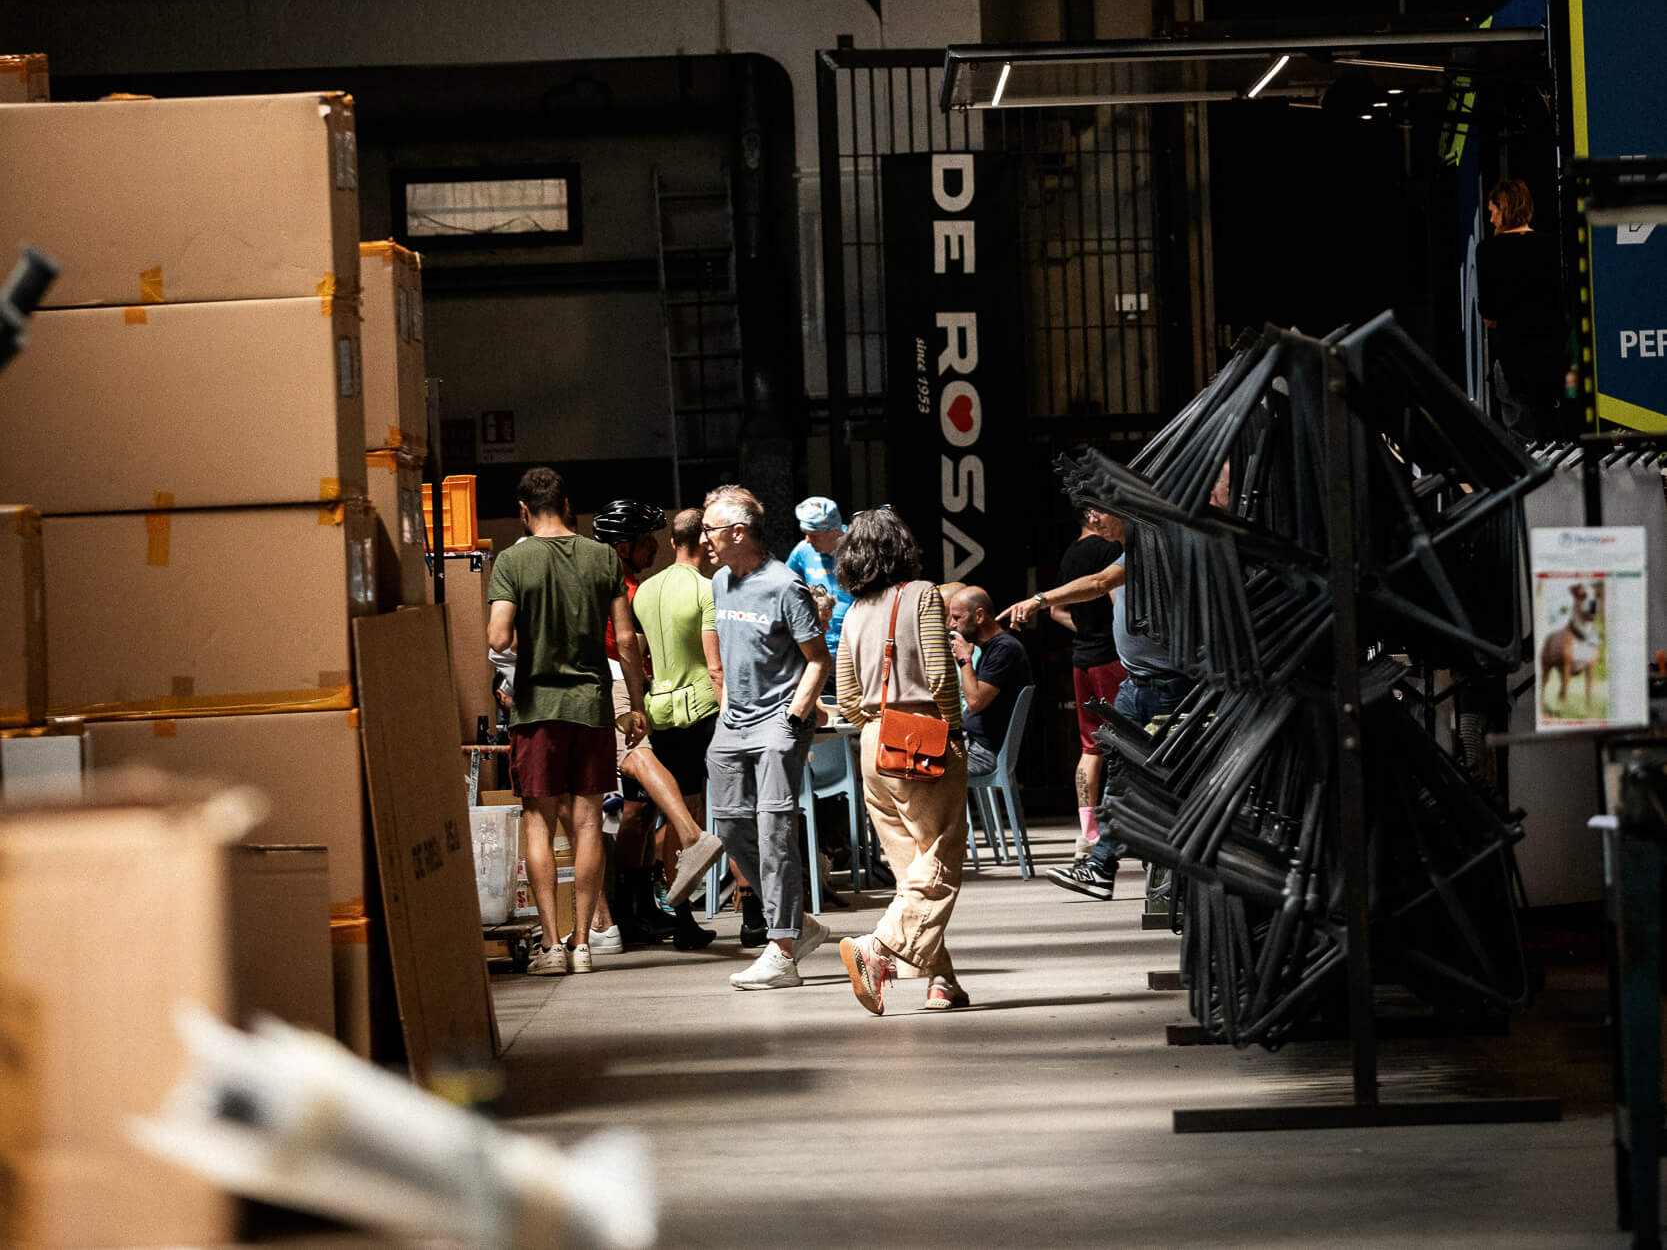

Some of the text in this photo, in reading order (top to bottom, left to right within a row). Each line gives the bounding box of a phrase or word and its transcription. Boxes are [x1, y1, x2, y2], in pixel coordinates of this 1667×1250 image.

[915, 336, 931, 414] since 1953
[931, 153, 986, 584] DE ROSA
